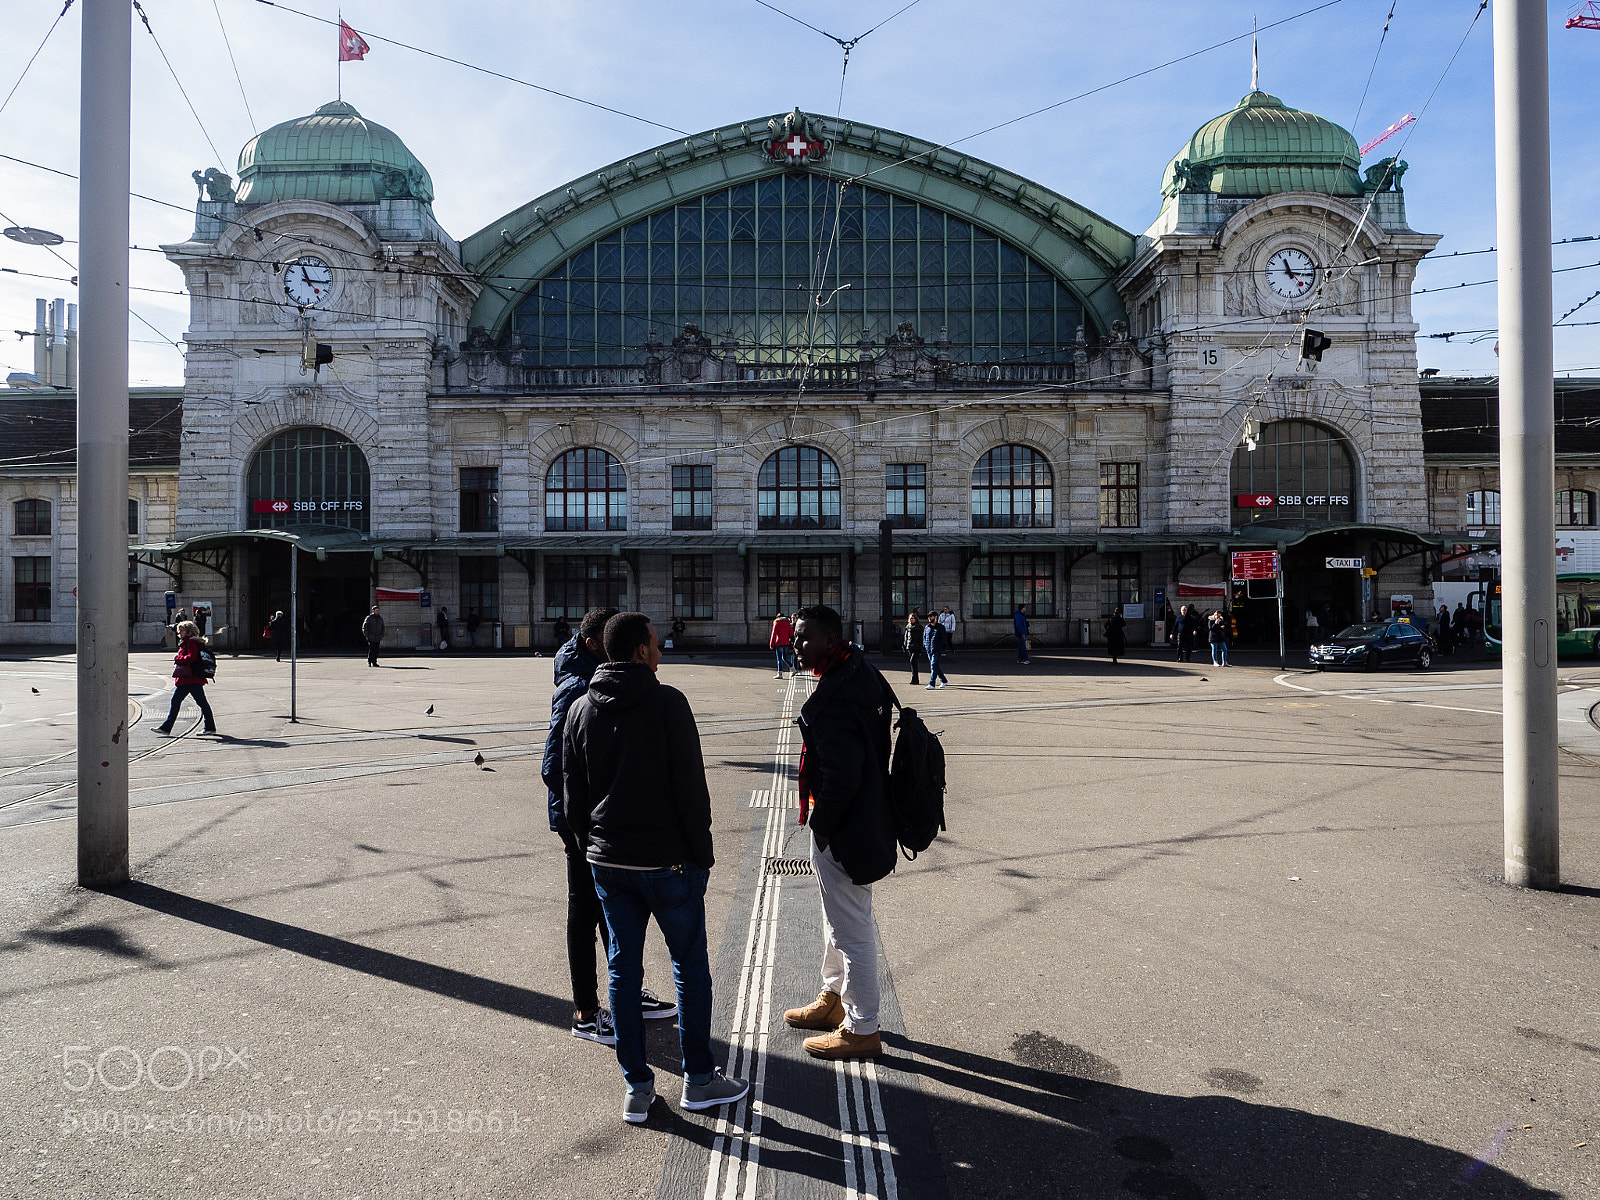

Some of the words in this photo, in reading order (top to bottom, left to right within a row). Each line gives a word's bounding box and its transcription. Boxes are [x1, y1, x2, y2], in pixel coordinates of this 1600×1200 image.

[1202, 349, 1217, 365] 15
[1278, 495, 1301, 505] SBB
[1305, 495, 1326, 505] CFF
[1329, 495, 1349, 505] FFS
[293, 501, 316, 511] SBB
[320, 501, 340, 511] CFF
[343, 500, 363, 510] FFS
[1335, 559, 1351, 567] TAXI
